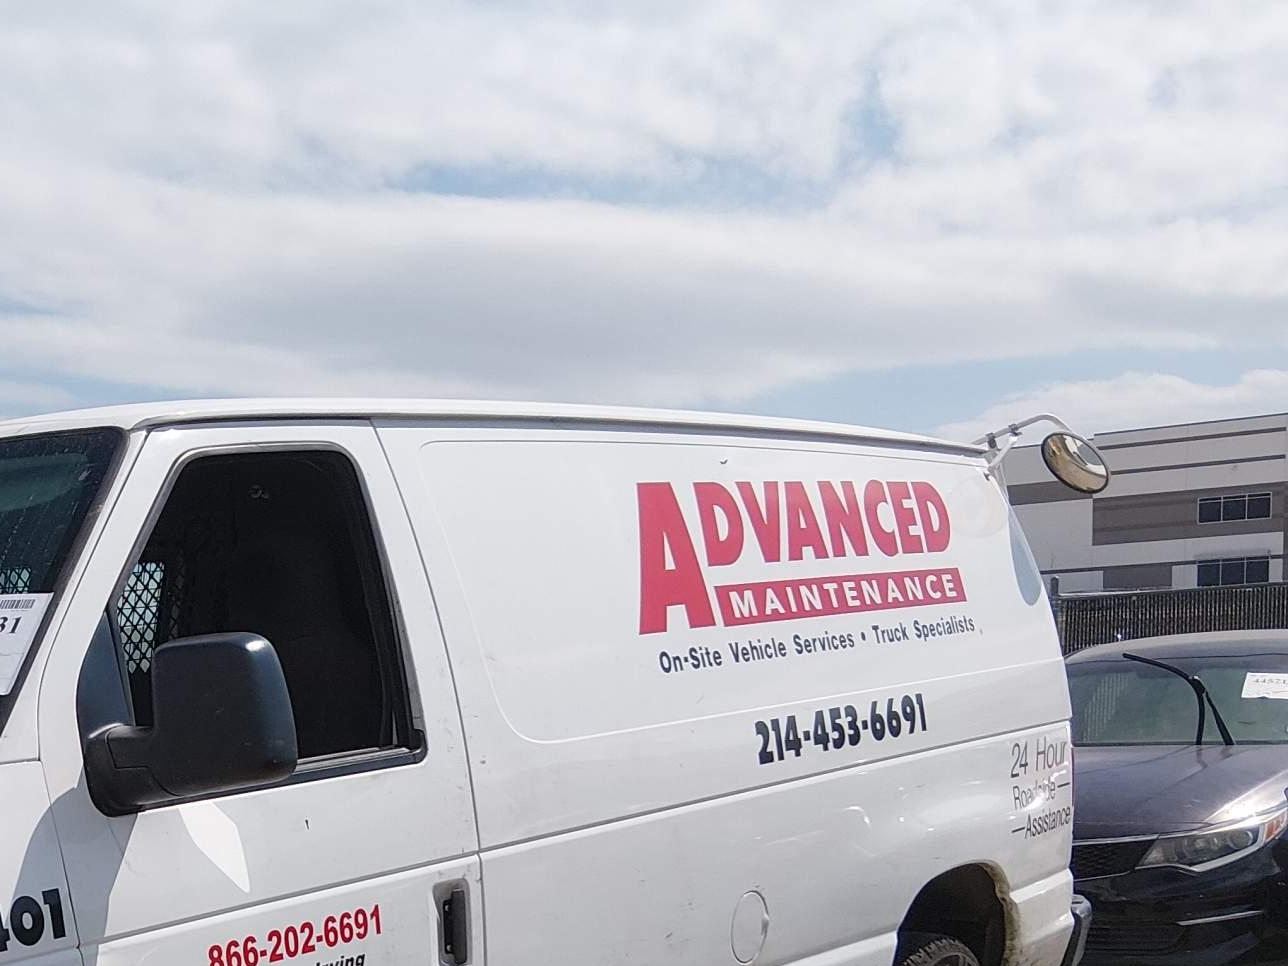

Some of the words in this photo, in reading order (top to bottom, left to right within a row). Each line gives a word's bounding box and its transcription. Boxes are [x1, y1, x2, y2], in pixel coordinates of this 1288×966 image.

[636, 479, 951, 635] ADVANCED
[728, 573, 958, 618] MAINTENANCE
[658, 646, 723, 674] On-Site
[728, 637, 787, 664] Vehicle
[793, 629, 855, 655] Services
[871, 622, 910, 645] Truck
[913, 615, 976, 640] Specialists
[754, 693, 928, 766] 214-453-6691
[1011, 741, 1029, 778] 24
[1035, 735, 1068, 772] Hour
[1024, 805, 1071, 840] Assistance
